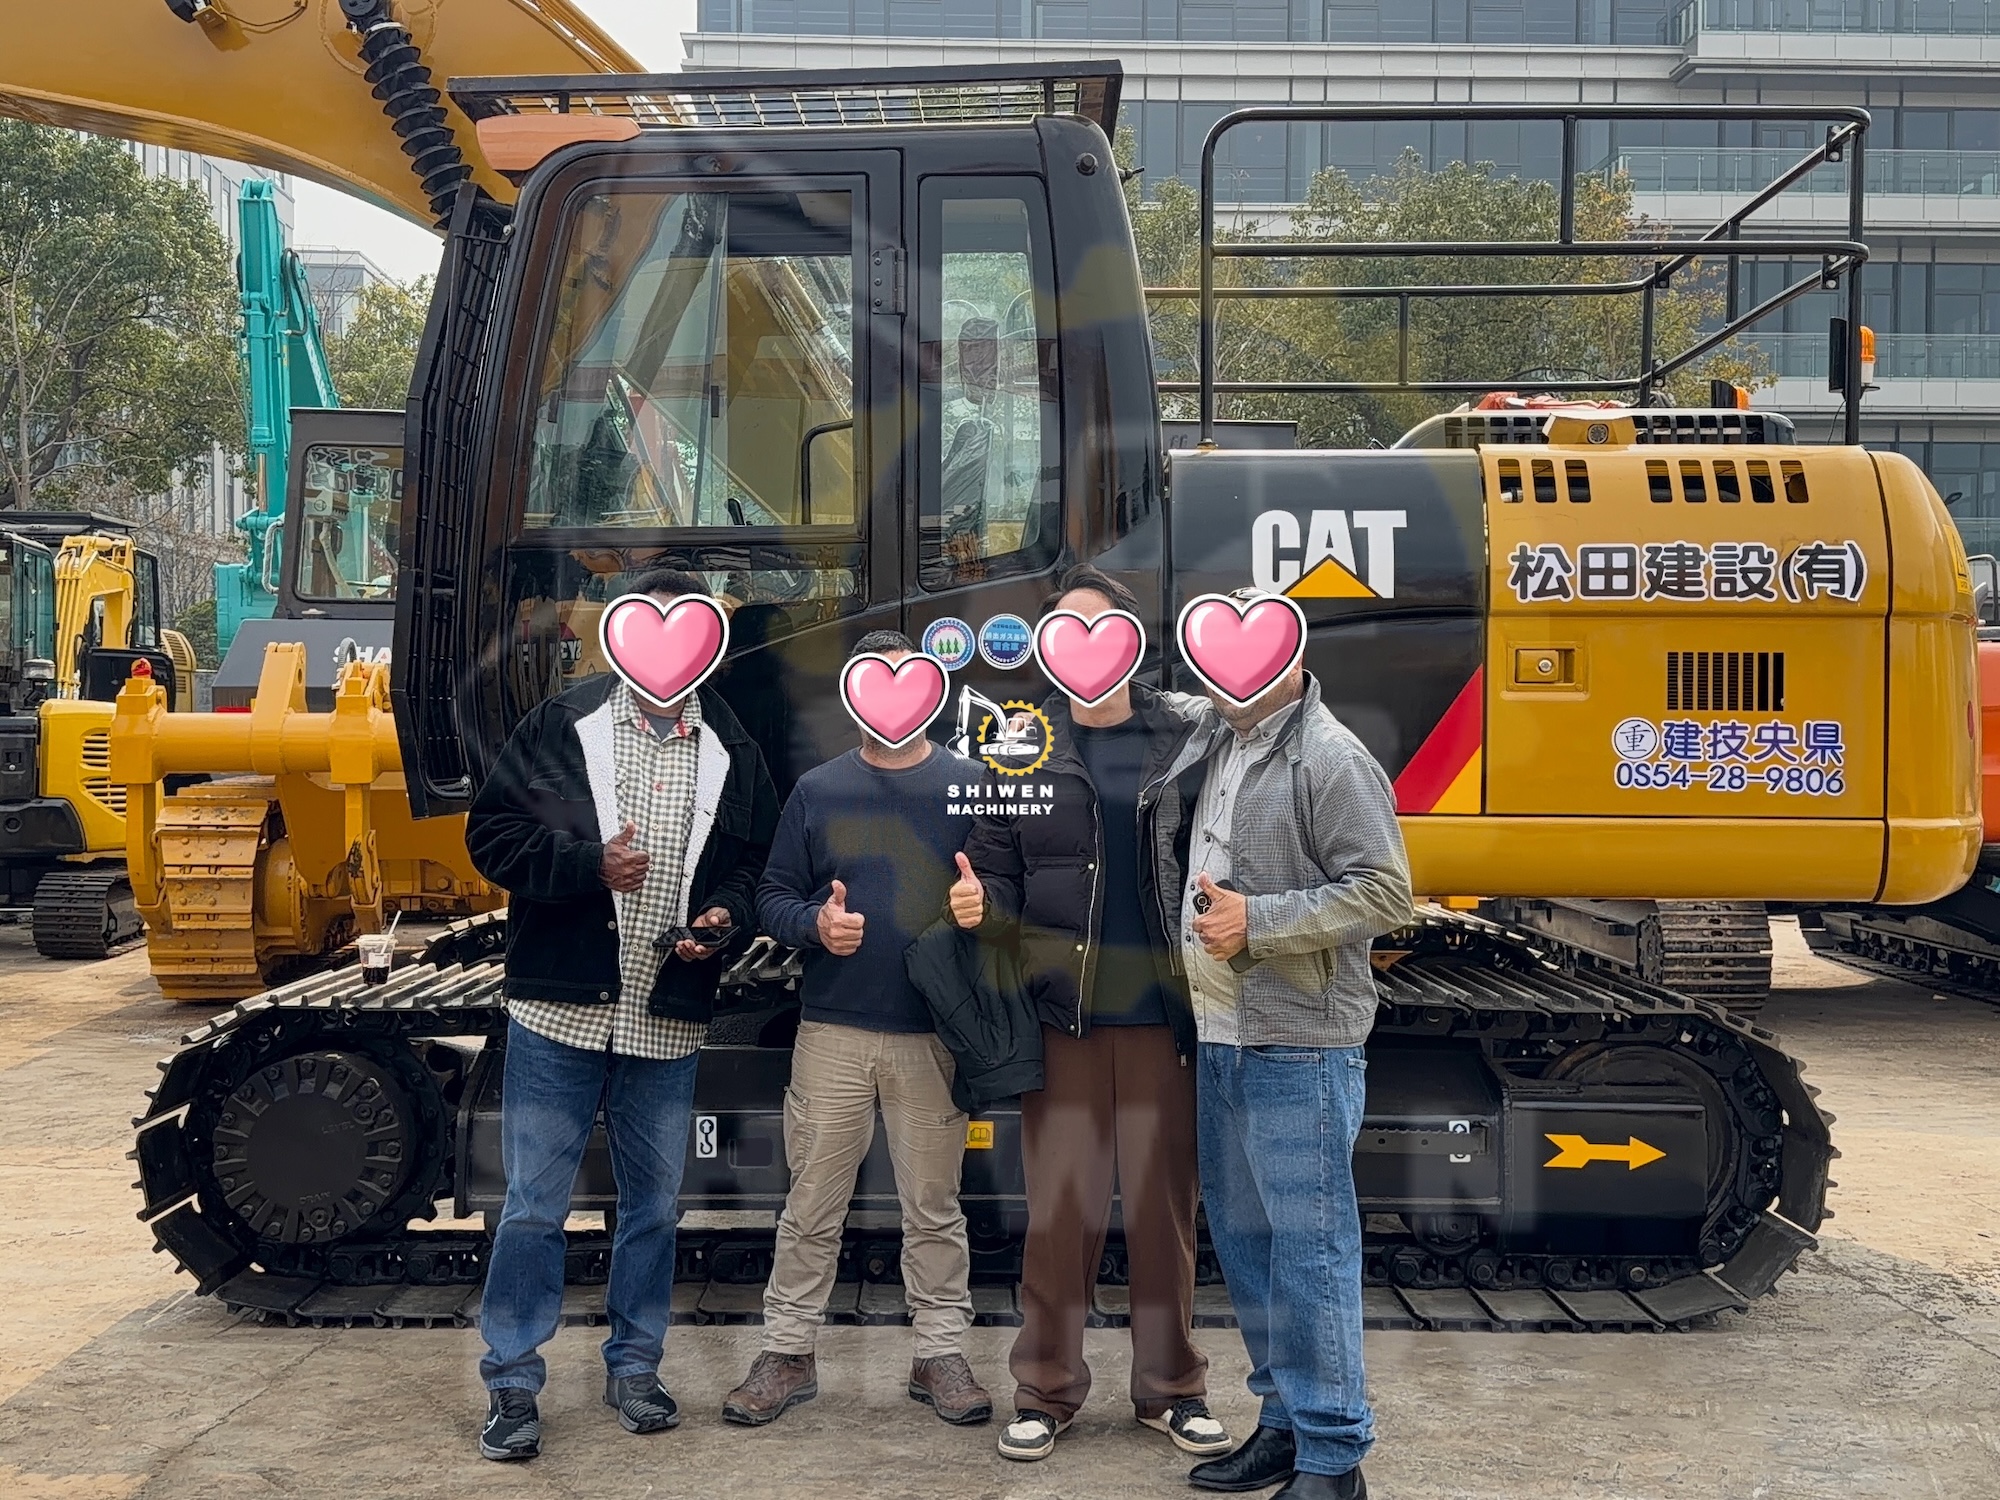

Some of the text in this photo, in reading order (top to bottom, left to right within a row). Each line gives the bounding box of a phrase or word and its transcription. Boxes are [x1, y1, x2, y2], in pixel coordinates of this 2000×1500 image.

[1252, 510, 1407, 598] CAT
[1510, 542, 1865, 600] 松田建設(有)
